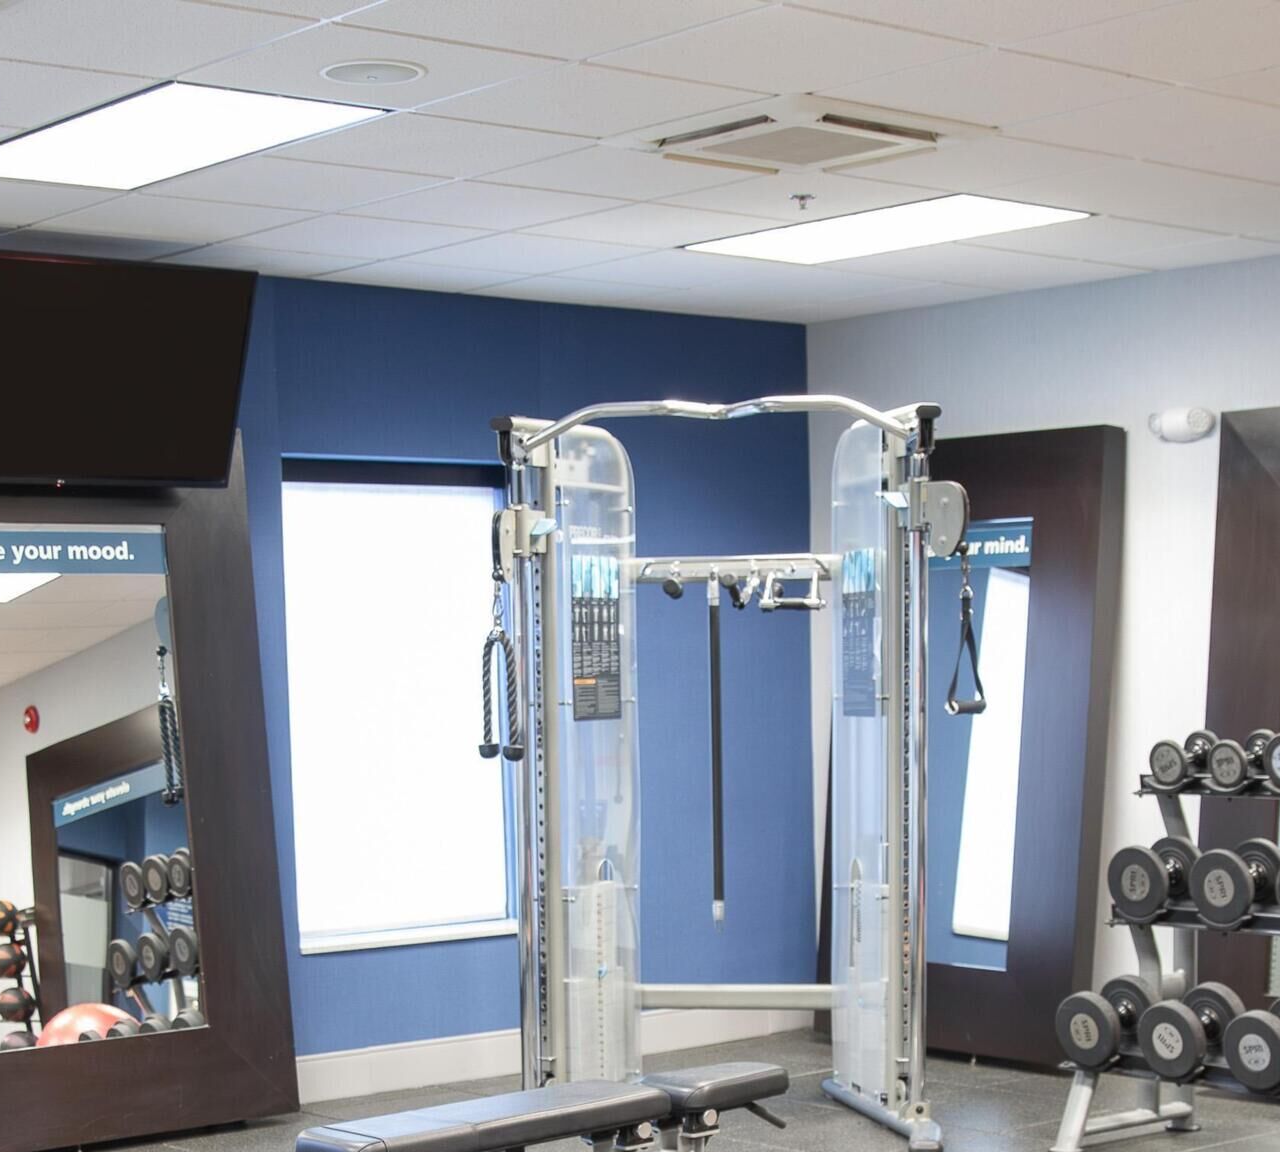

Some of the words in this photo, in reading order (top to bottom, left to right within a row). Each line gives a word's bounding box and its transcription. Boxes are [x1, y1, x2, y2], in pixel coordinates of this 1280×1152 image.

[11, 544, 62, 565] your
[67, 541, 135, 560] mood.
[983, 535, 1030, 555] mind.
[1128, 870, 1138, 894] SPRI
[1214, 875, 1228, 900] SPRI
[1080, 1018, 1093, 1043] SPRI
[1155, 1033, 1176, 1054] SPRI
[1242, 1044, 1265, 1057] SPRI
